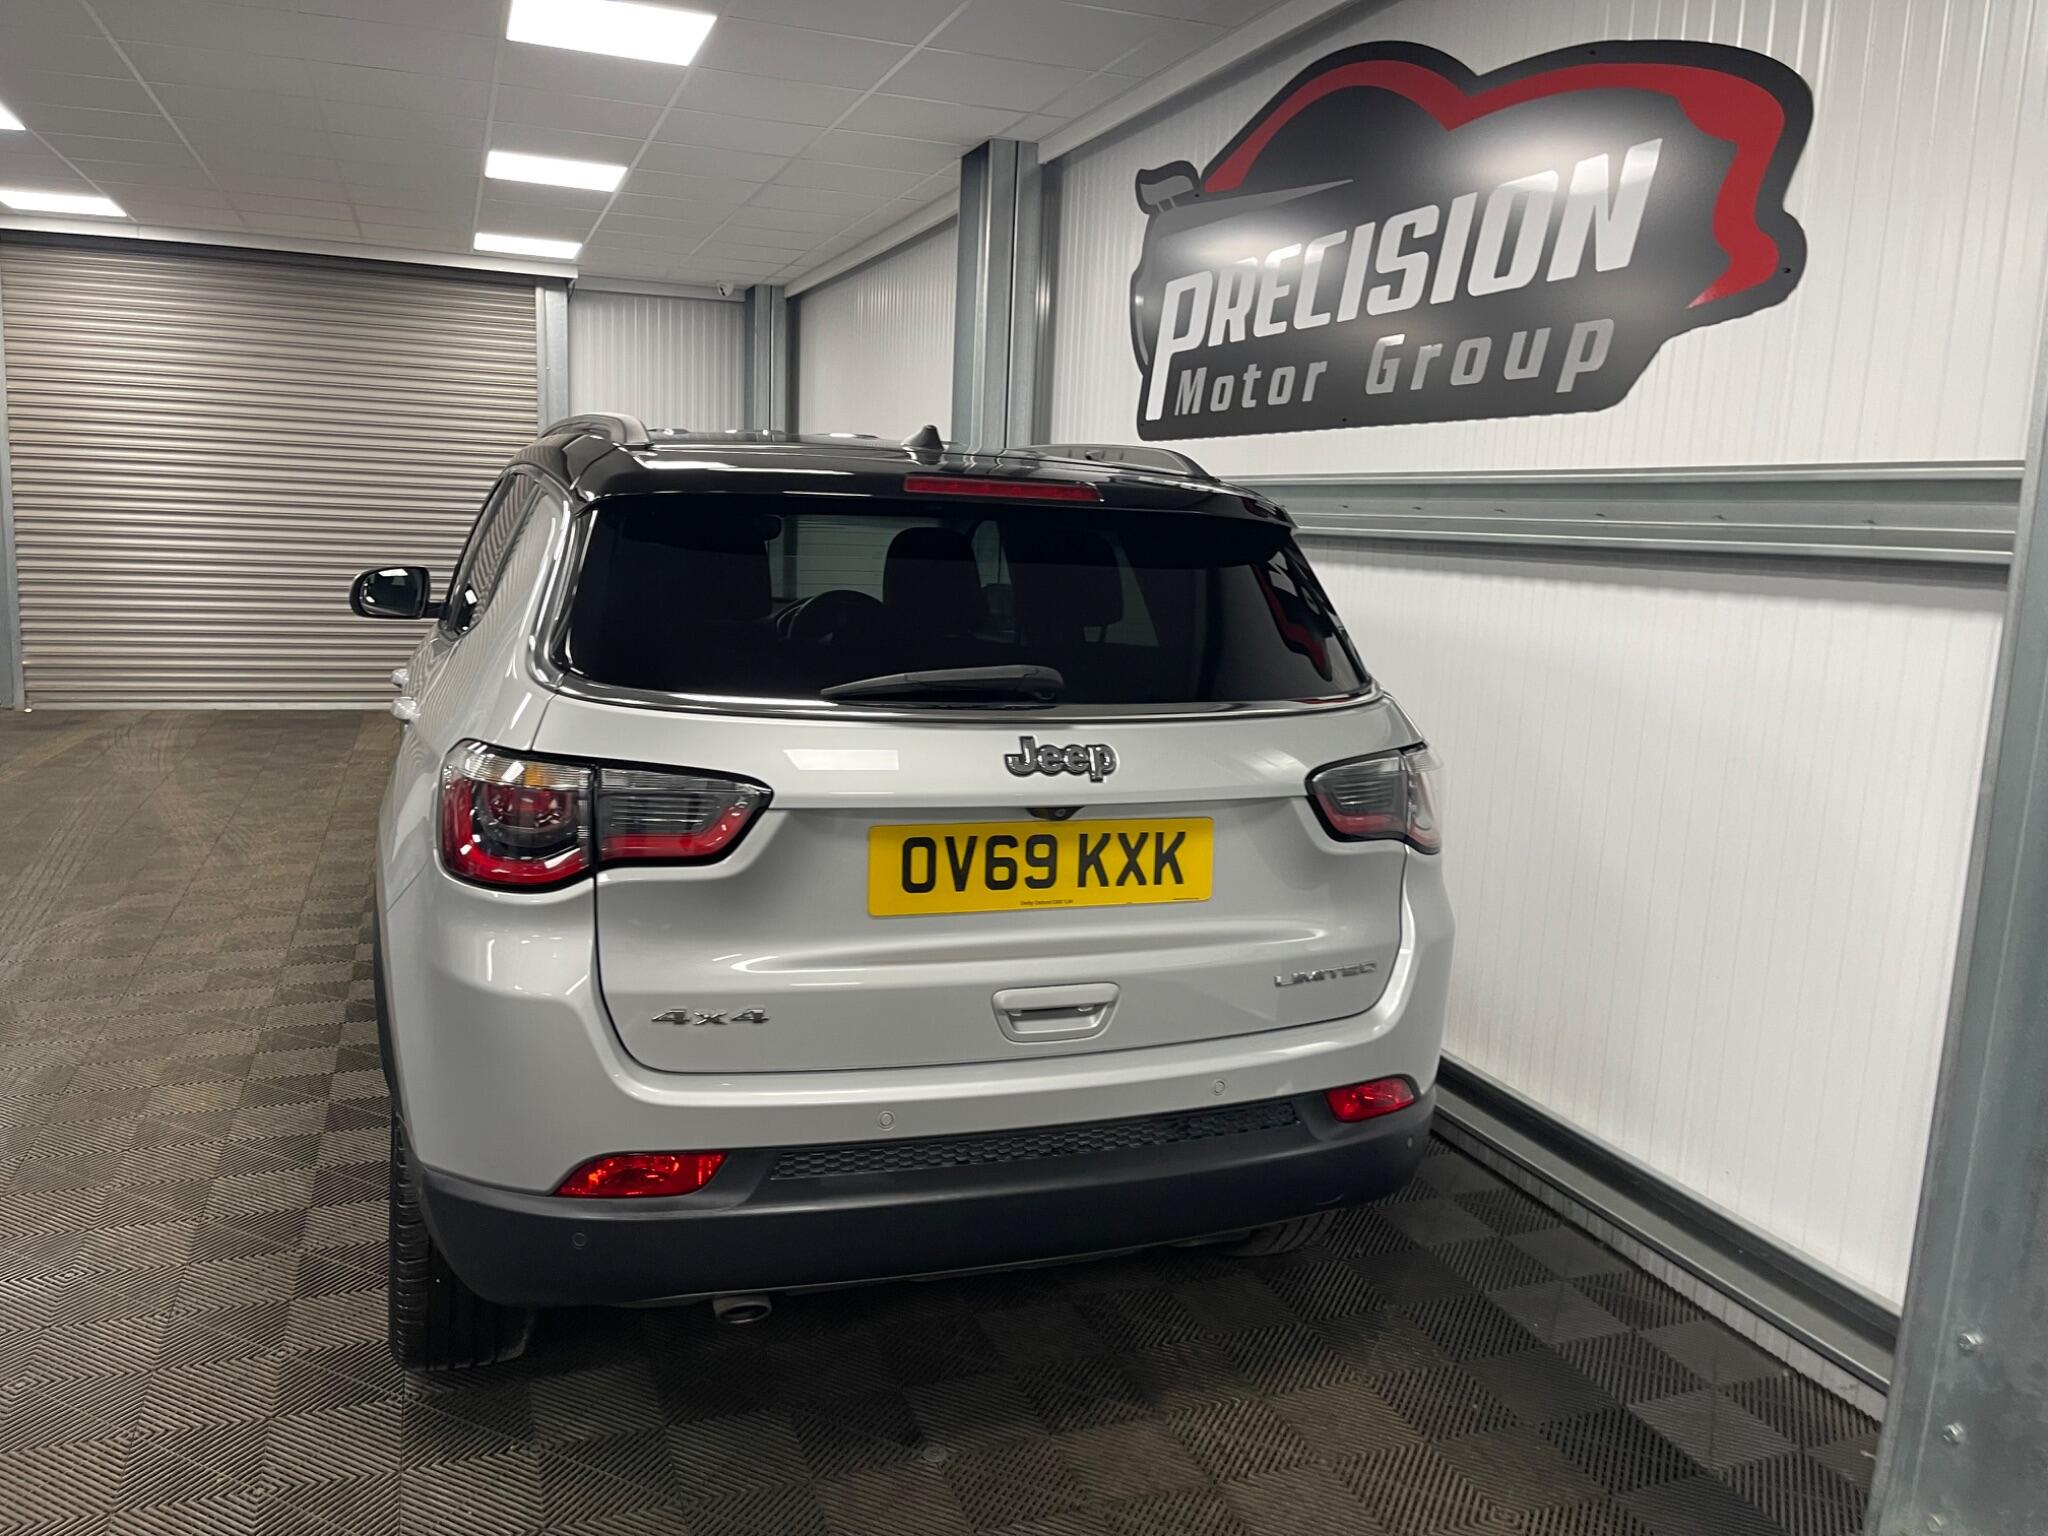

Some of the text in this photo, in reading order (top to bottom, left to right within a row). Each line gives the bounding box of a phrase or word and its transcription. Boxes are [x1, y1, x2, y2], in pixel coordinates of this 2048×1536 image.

[1145, 138, 1663, 421] PRECISION
[1174, 318, 1615, 417] Motor Group
[1005, 736, 1117, 783] Jeep
[901, 831, 1186, 893] OV69 KXK
[1274, 962, 1377, 987] LIMITED
